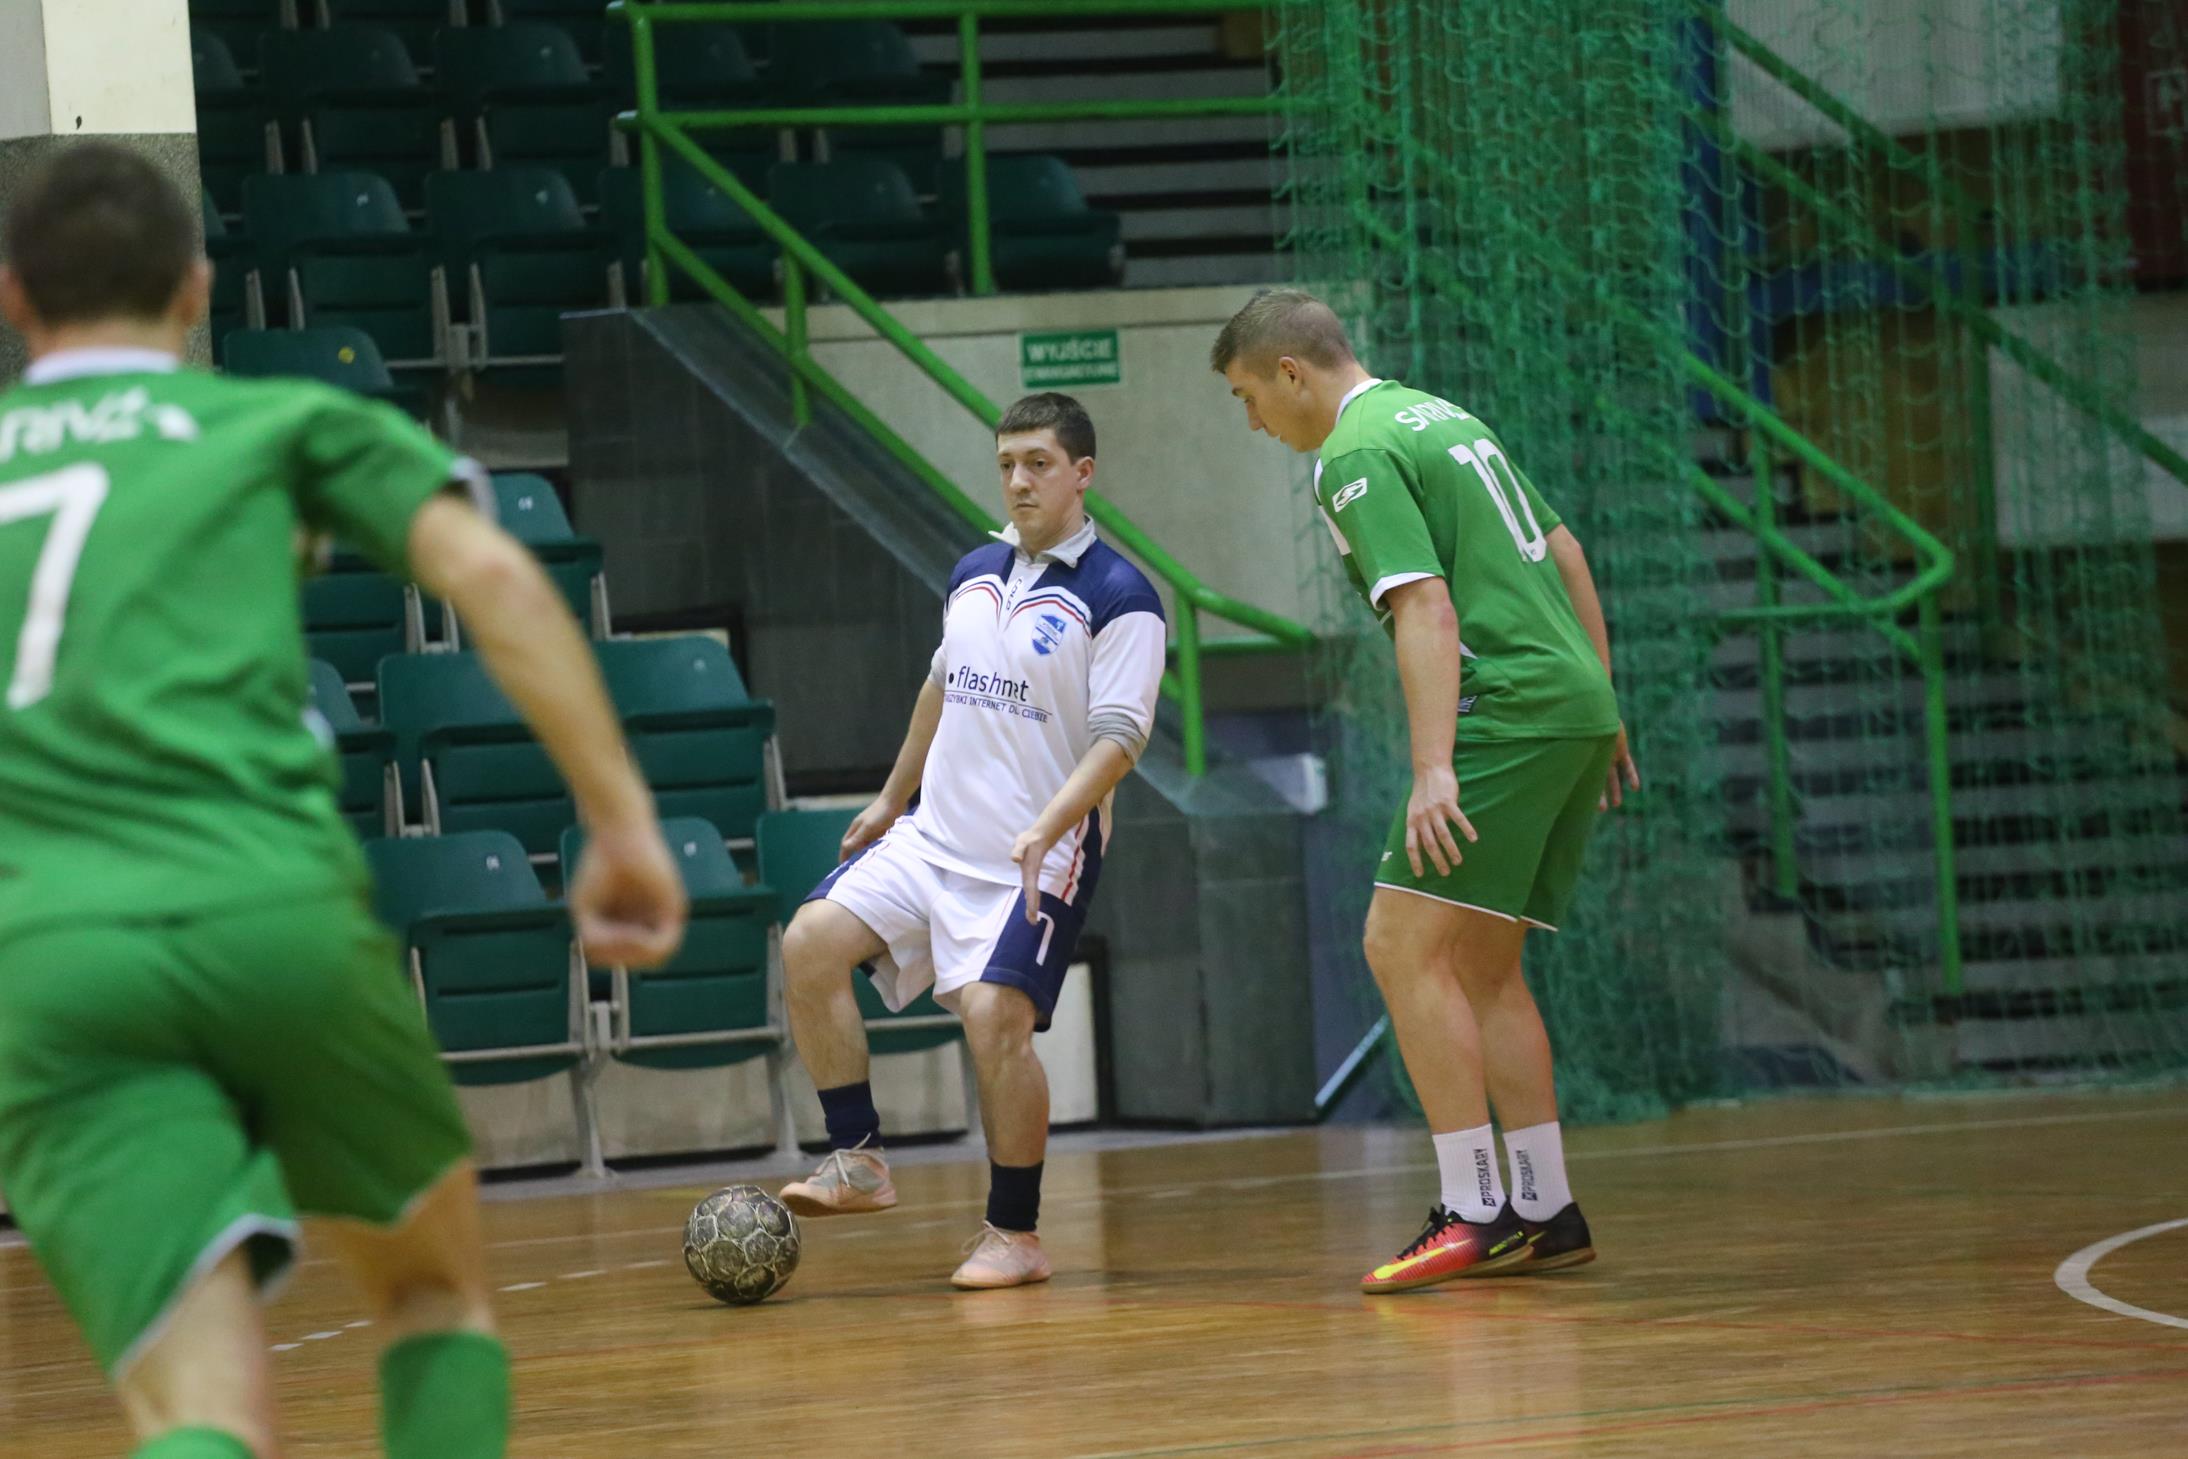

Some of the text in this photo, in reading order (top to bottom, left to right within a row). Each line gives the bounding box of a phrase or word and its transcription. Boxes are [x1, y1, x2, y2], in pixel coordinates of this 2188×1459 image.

[1448, 438, 1547, 562] 10
[0, 460, 111, 711] 7
[969, 695, 1006, 712] INTERNET
[1035, 909, 1056, 967] 7
